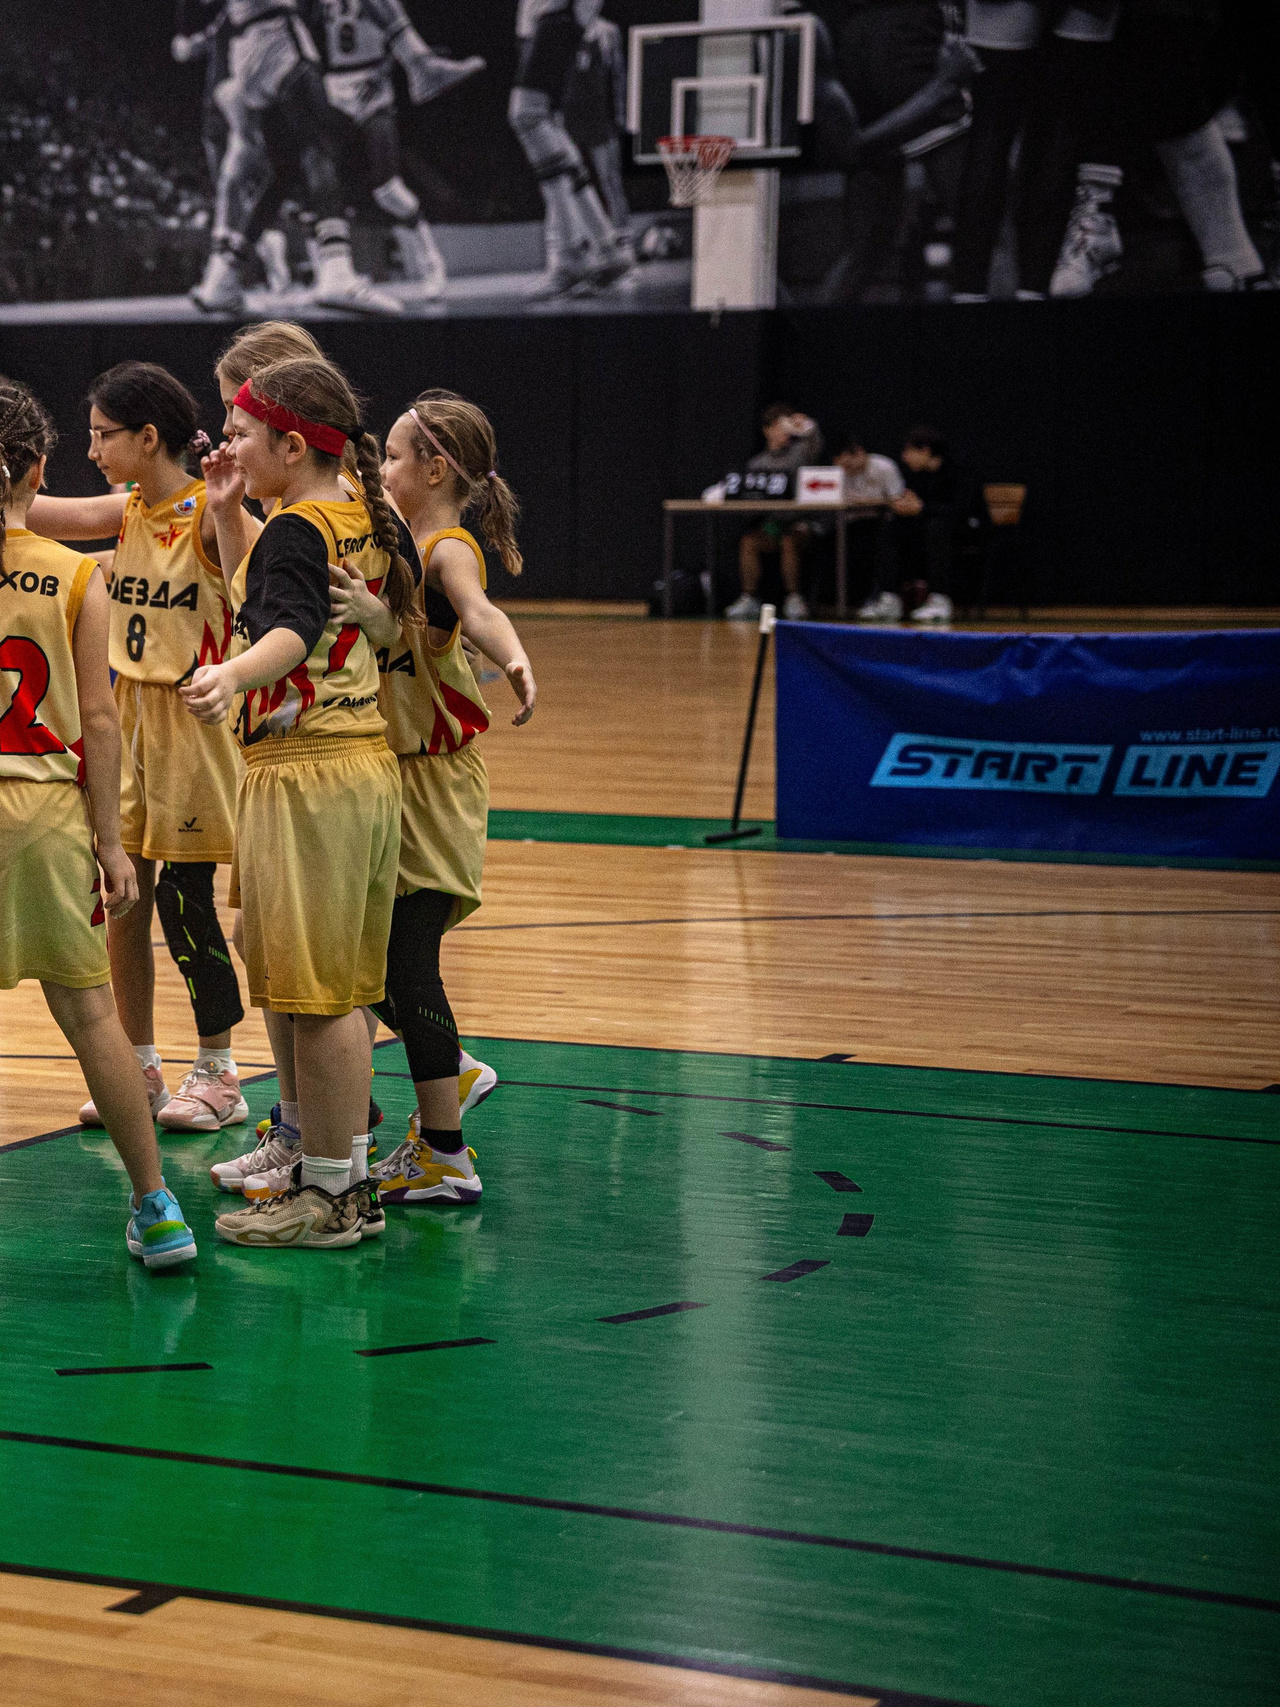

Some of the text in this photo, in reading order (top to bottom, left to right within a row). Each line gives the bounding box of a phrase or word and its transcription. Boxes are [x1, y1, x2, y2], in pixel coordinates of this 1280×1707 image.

[126, 612, 147, 663] 8
[889, 743, 1269, 788] START LINE
